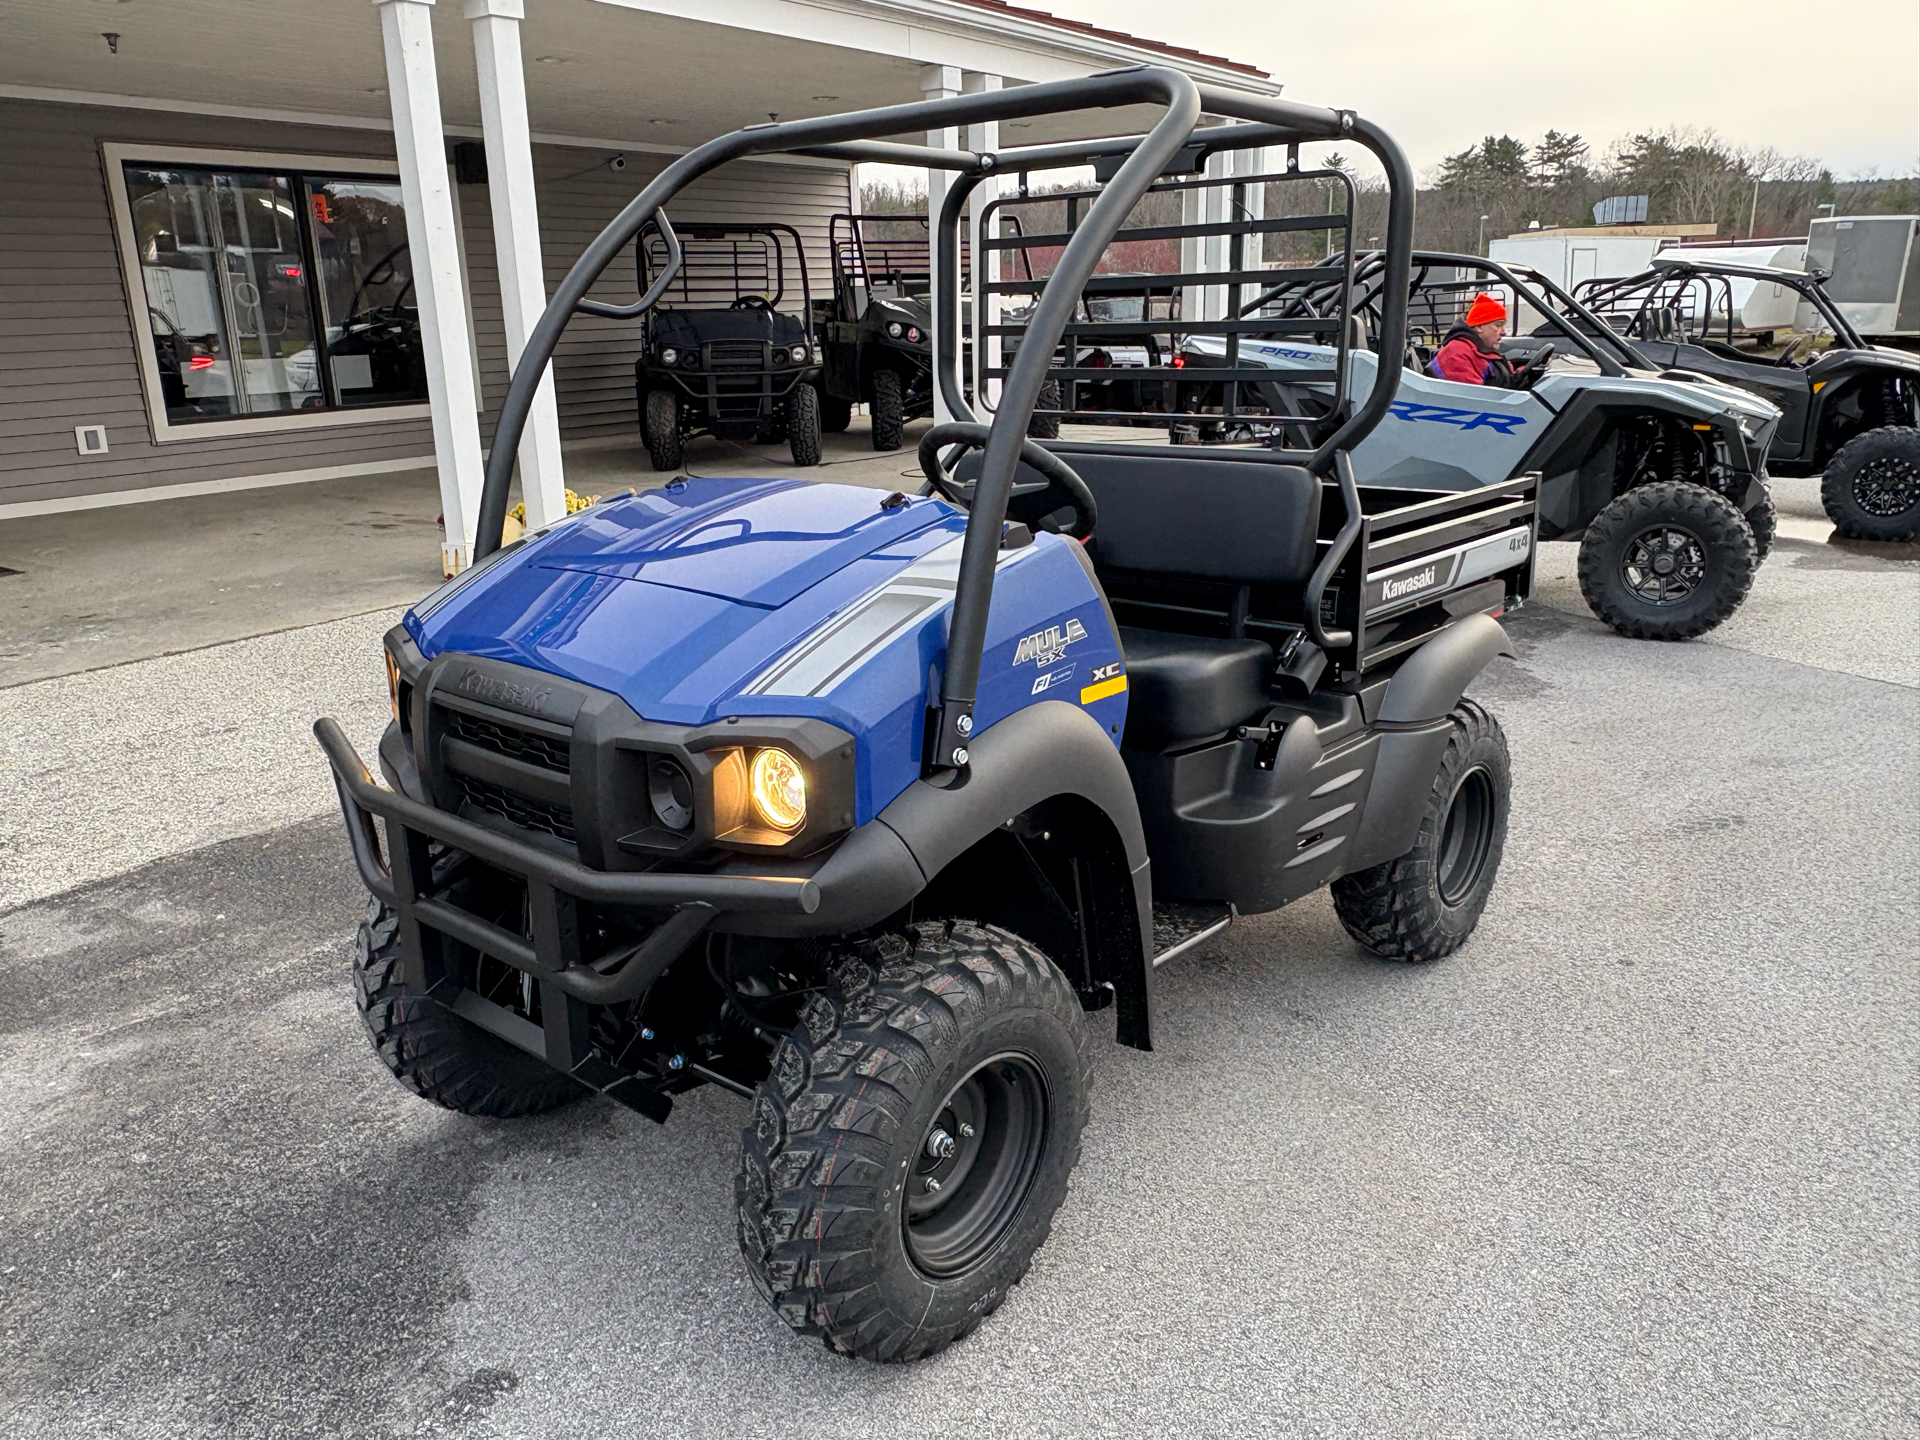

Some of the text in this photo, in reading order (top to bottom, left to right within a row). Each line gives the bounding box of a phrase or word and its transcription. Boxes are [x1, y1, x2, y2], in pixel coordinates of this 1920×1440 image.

[1259, 346, 1313, 360] PRO
[1509, 534, 1528, 551] 4x4
[1382, 565, 1436, 601] Kawasaki
[1012, 618, 1088, 667] MULE
[1036, 647, 1066, 669] SX
[1092, 662, 1120, 681] XC
[1033, 674, 1051, 693] FI
